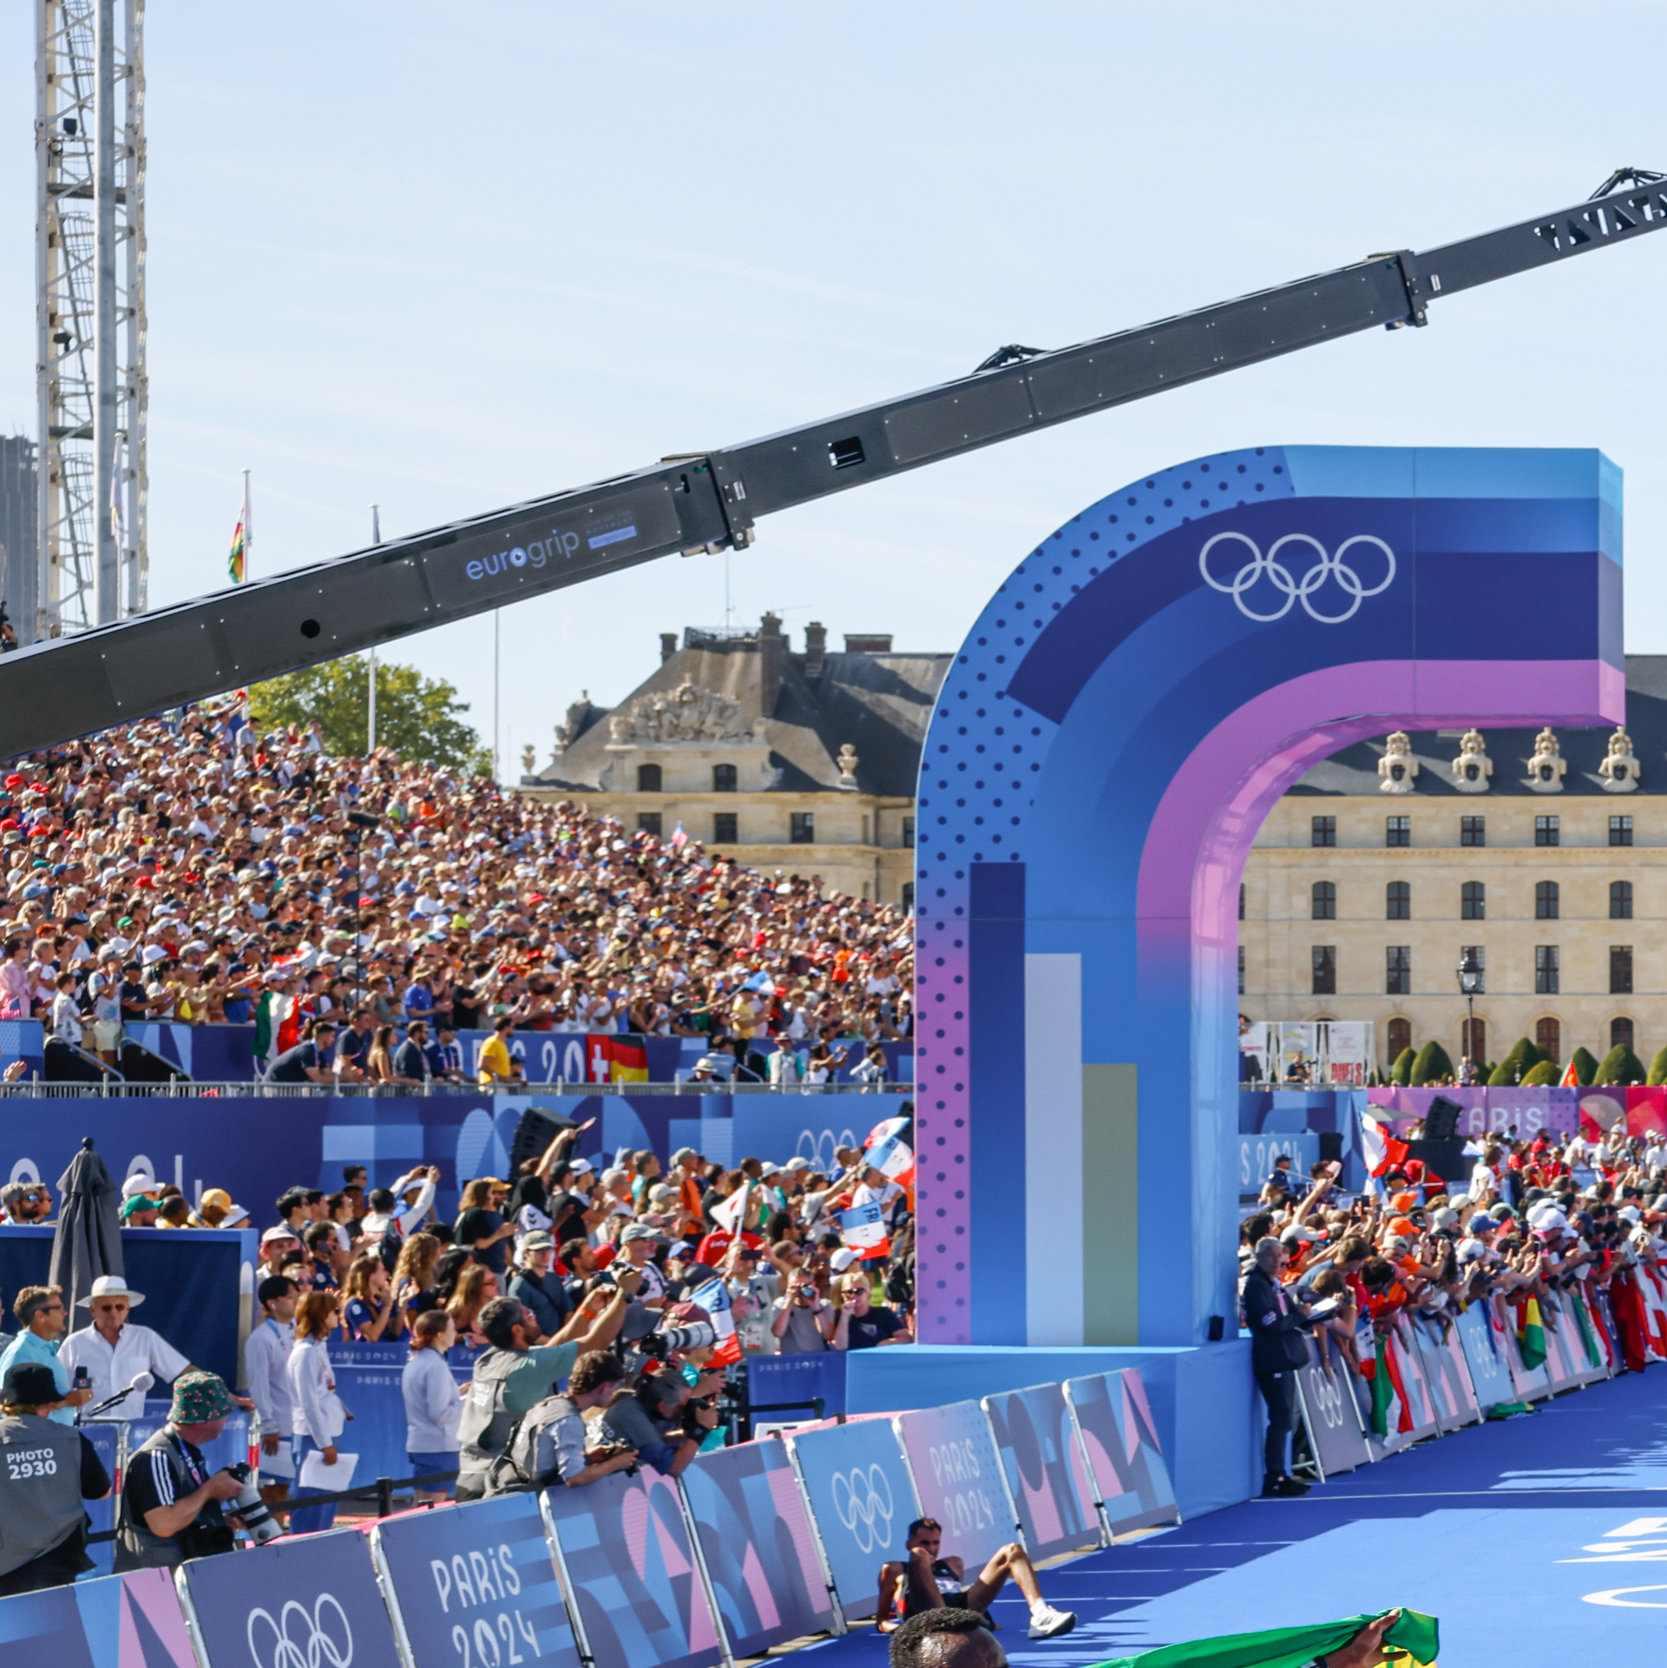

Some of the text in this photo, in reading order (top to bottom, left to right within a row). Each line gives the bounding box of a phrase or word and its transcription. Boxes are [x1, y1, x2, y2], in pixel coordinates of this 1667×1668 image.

[466, 529, 580, 580] eurogrip
[1468, 1106, 1544, 1133] ARiS
[6, 1448, 54, 1464] PHOTO
[9, 1459, 57, 1480] 2930
[944, 1488, 994, 1537] 2024
